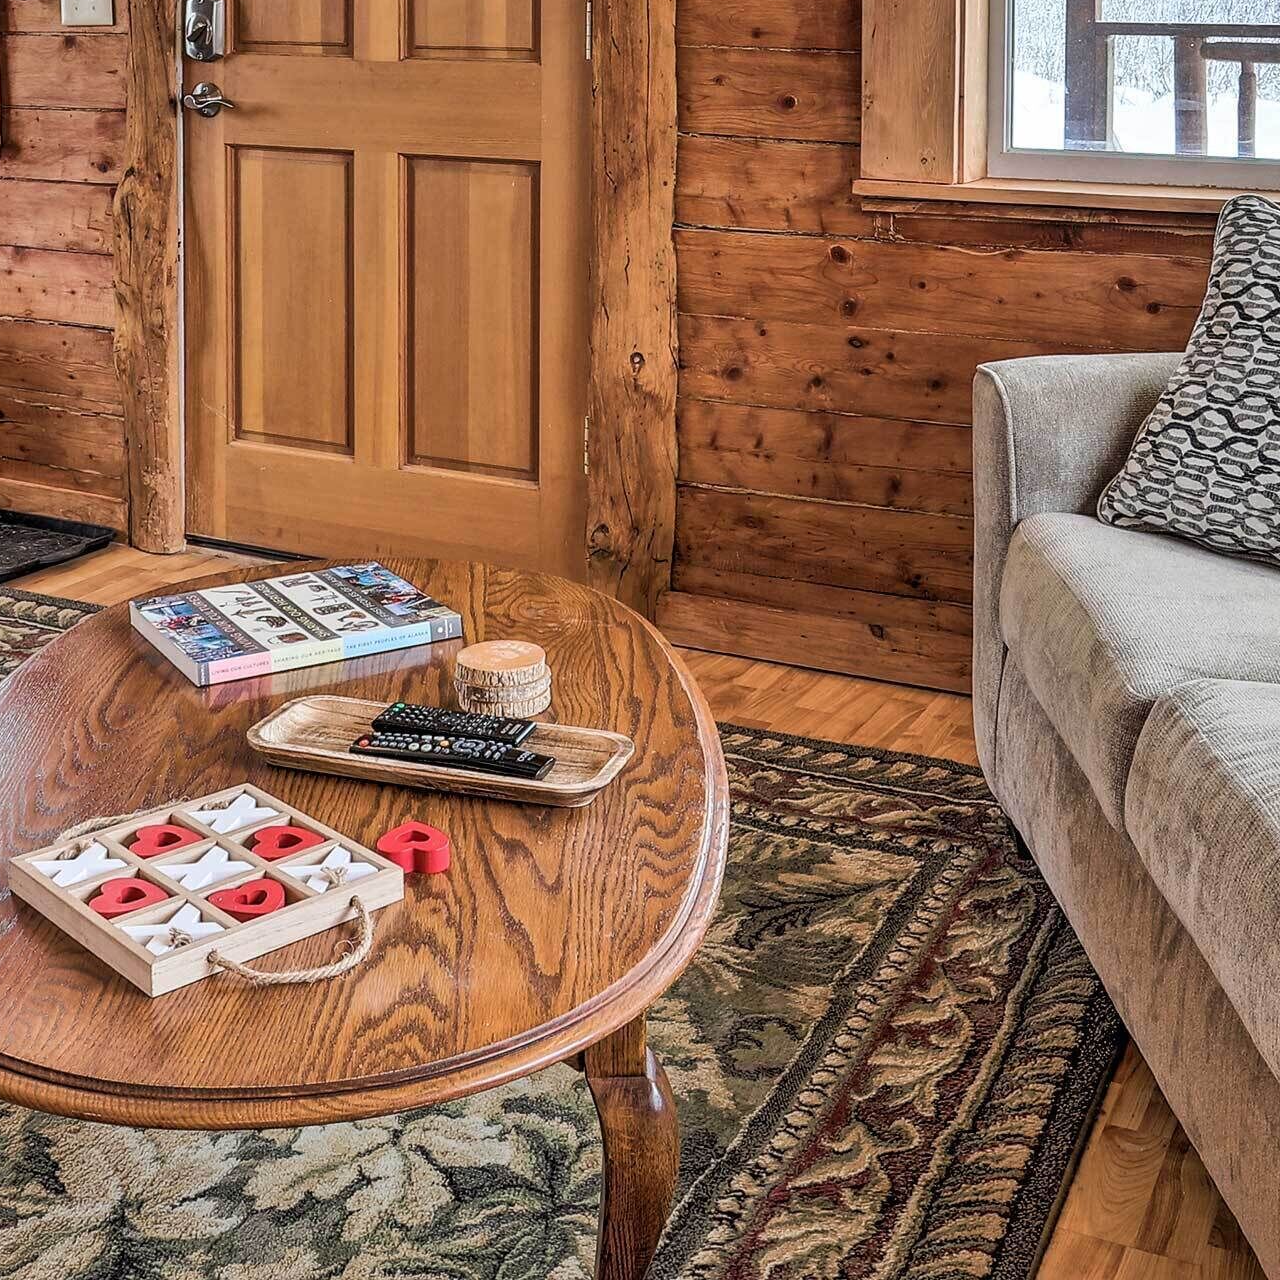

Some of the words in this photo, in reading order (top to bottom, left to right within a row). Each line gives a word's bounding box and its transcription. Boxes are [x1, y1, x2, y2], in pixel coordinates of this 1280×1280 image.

[254, 583, 289, 606] HERITAGE
[185, 594, 222, 621] CULTURES
[282, 604, 302, 616] OUR
[215, 620, 236, 632] OUR
[296, 615, 331, 637] SHARING
[229, 632, 259, 651] LIVING
[358, 640, 373, 648] FIRST
[374, 635, 398, 645] PEOPLES
[407, 629, 429, 639] ALASKA
[273, 655, 299, 664] SHARING
[301, 651, 313, 659] OUR
[210, 667, 230, 676] LIVING
[243, 661, 270, 670] CULTURES
